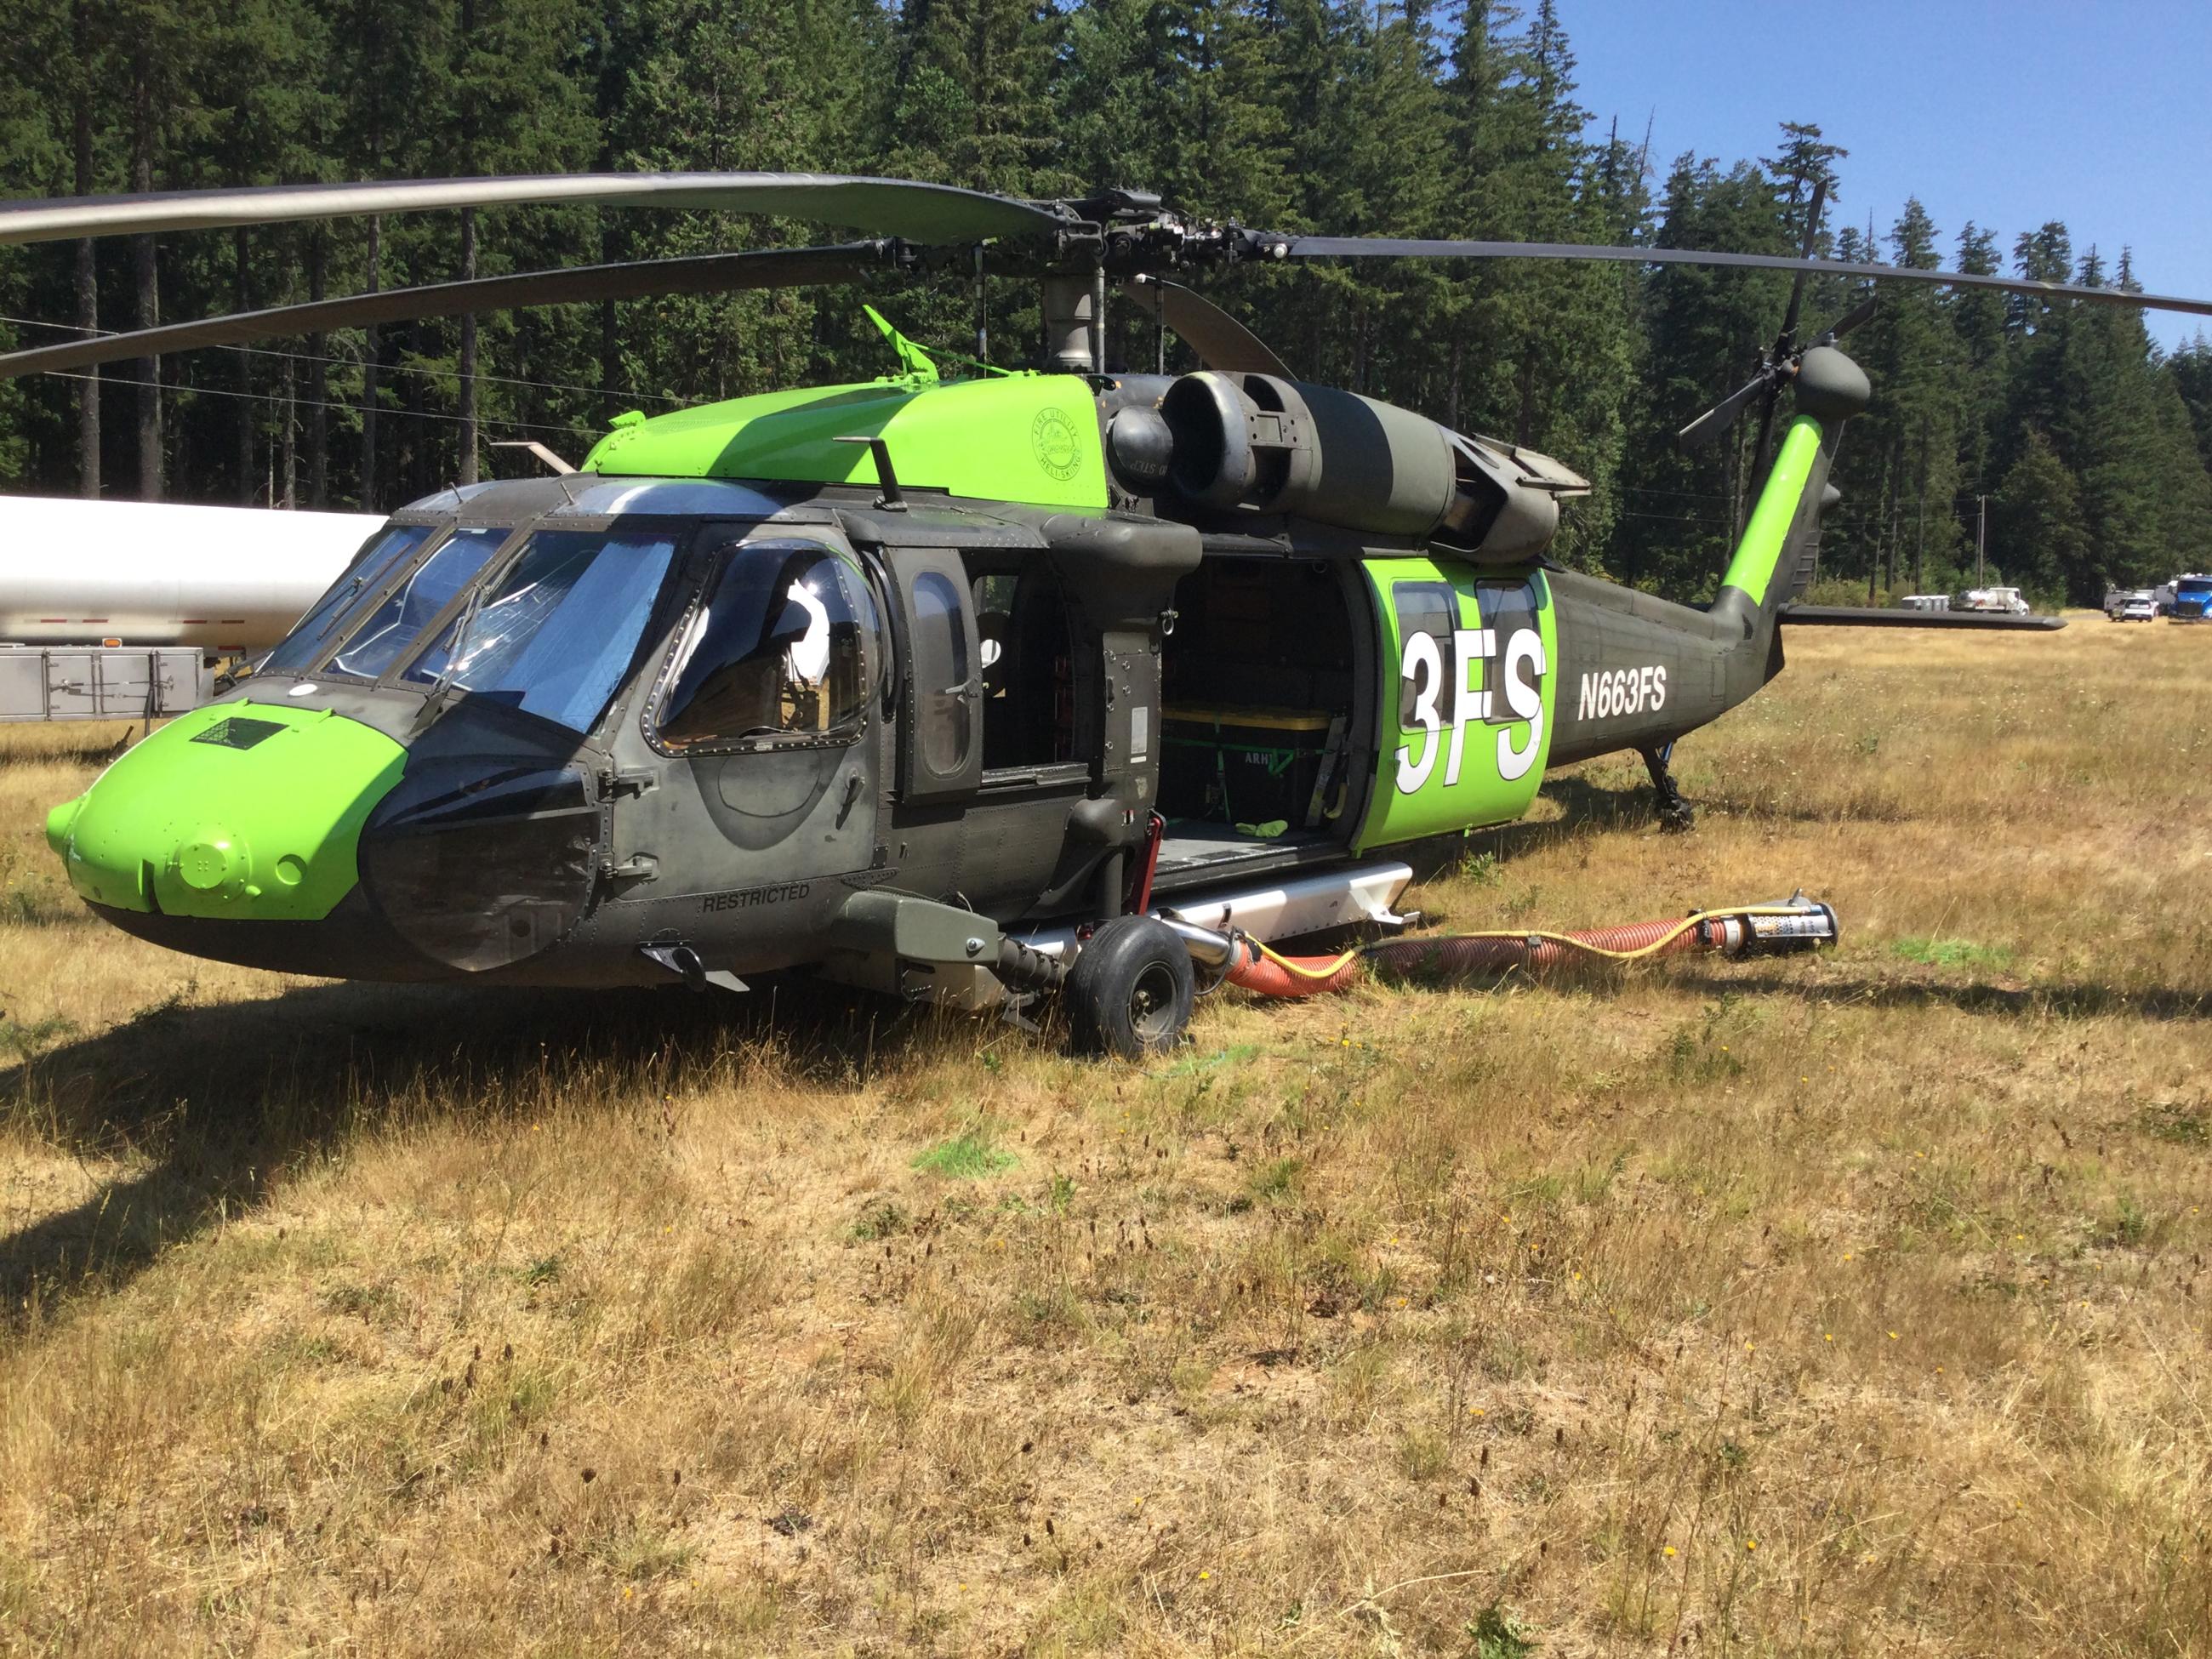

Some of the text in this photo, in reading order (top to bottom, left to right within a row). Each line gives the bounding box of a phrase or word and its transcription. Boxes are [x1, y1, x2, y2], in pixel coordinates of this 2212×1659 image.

[1034, 410, 1079, 436] FIRE UTILITY
[1394, 628, 1547, 795] 3FS
[1577, 665, 1668, 721] N663FS
[703, 884, 810, 913] RESTRICTED
